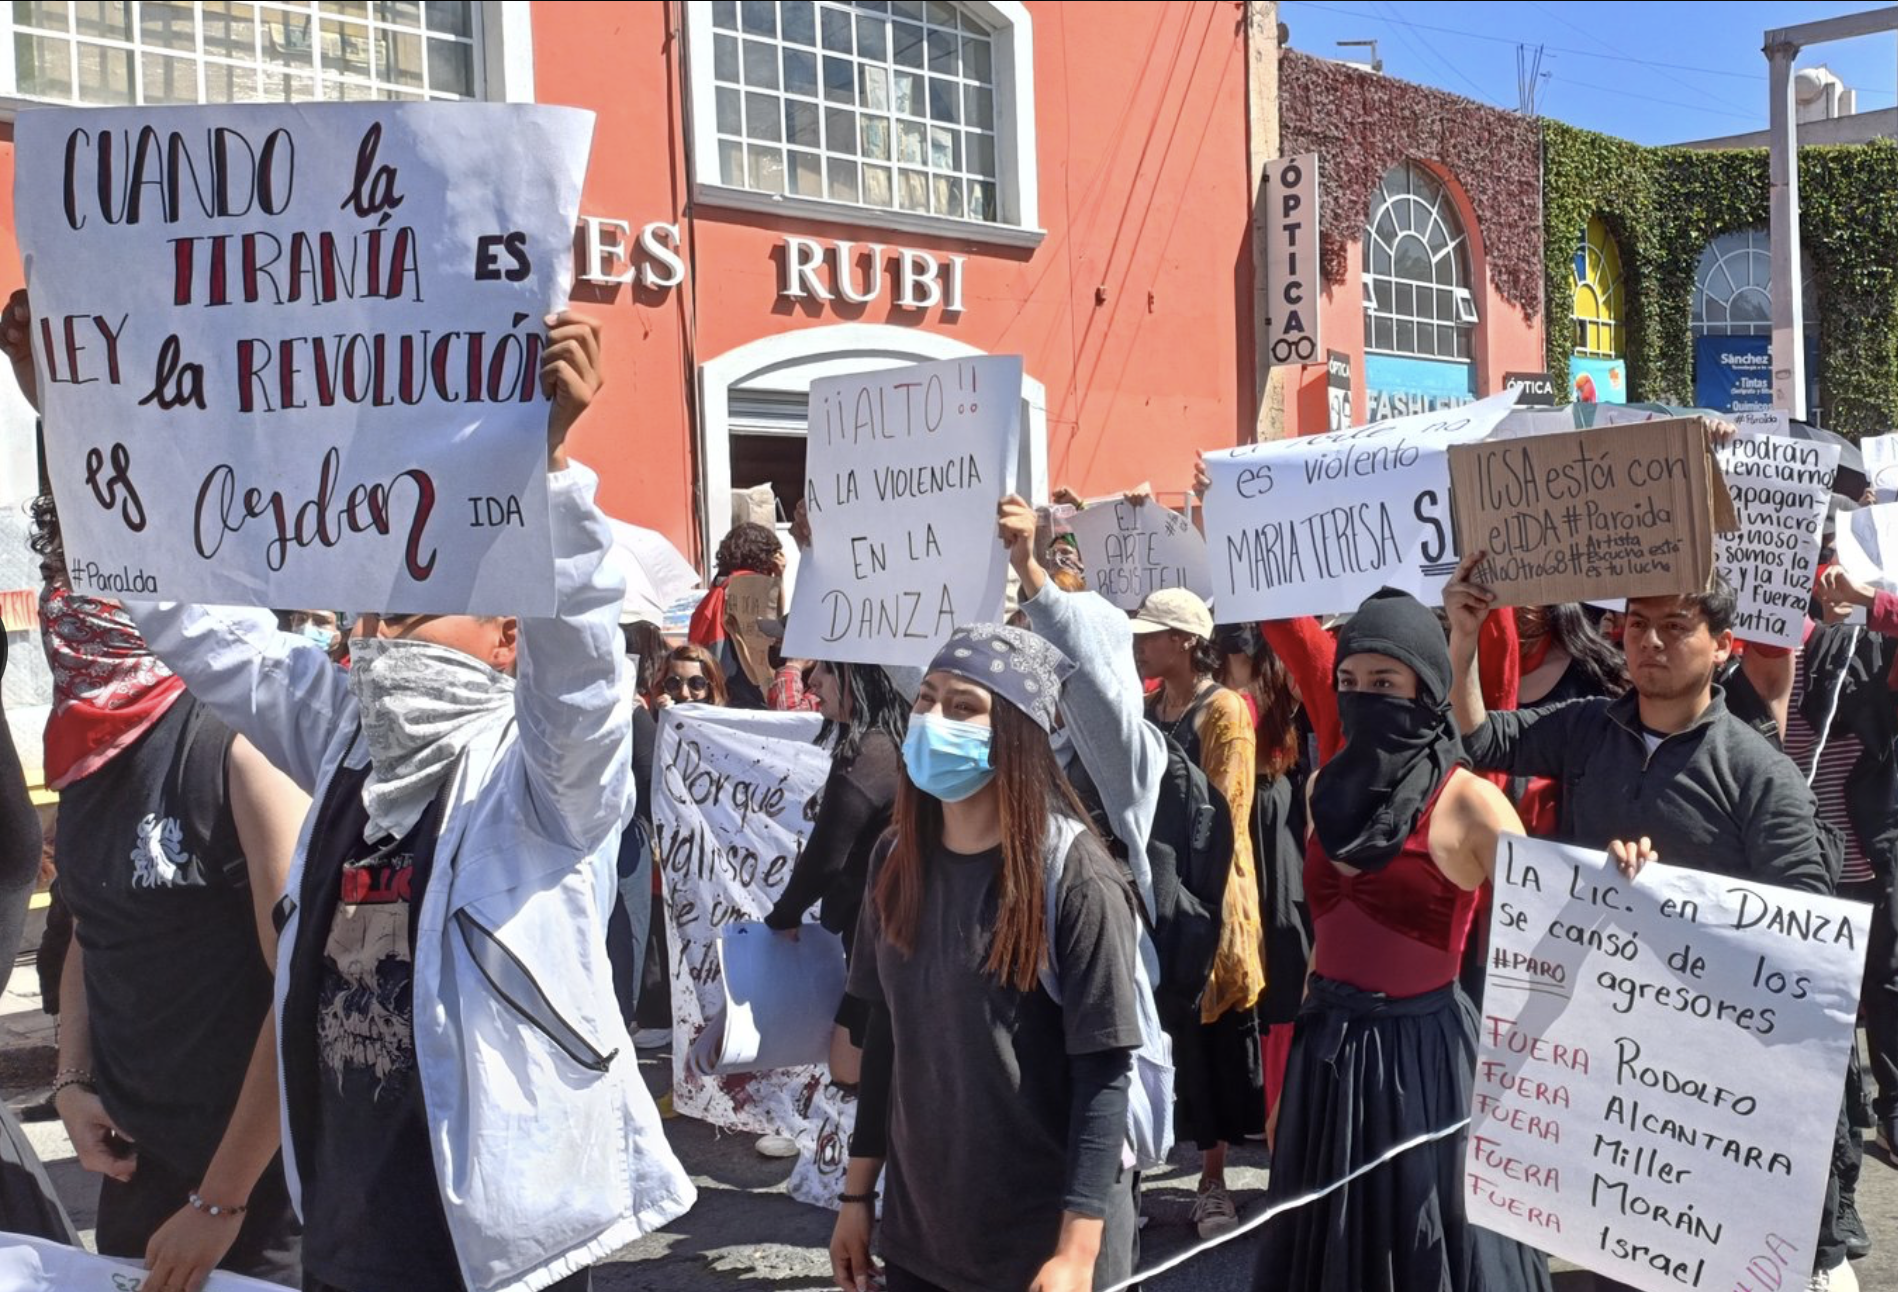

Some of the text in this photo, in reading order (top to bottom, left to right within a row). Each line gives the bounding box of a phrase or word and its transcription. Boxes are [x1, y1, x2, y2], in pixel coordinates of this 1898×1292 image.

[63, 122, 405, 230] CUANDO la
[167, 213, 531, 307] TIRANÍA ES
[783, 236, 966, 312] RUBI
[1280, 159, 1305, 334] ÓPTICA
[41, 313, 128, 385] LEY
[138, 334, 207, 410] la
[1741, 377, 1768, 388] Tintas
[85, 442, 147, 532] es
[468, 496, 524, 528] IDA
[836, 469, 859, 505] LA
[874, 454, 981, 501] VIOLENCIA
[1236, 439, 1419, 499] es violento
[1477, 440, 1687, 511] ICSA está con
[851, 523, 941, 580] EN LA
[1105, 532, 1160, 566] ARTE
[1227, 520, 1305, 595] MARIA
[1300, 502, 1402, 580] TERESA
[1725, 545, 1786, 568] somos
[1790, 551, 1810, 572] la
[1739, 566, 1747, 592] y
[1754, 565, 1772, 584] la
[821, 583, 955, 642] DANZA
[1506, 841, 1541, 892] LA
[1660, 896, 1697, 923] en
[1727, 887, 1856, 951] DANZA
[1492, 947, 1776, 1035] #PARO agresores
[1548, 920, 1639, 962] cansó
[1668, 945, 1706, 979] de
[1753, 955, 1811, 1001] los
[1482, 1061, 1571, 1109] FUERA
[1486, 1015, 1757, 1116] FUERA RODOLFO
[1473, 1135, 1561, 1192] FUERA
[1476, 1093, 1693, 1185] FUERA Miller
[1467, 1173, 1705, 1288] FUERA Israel
